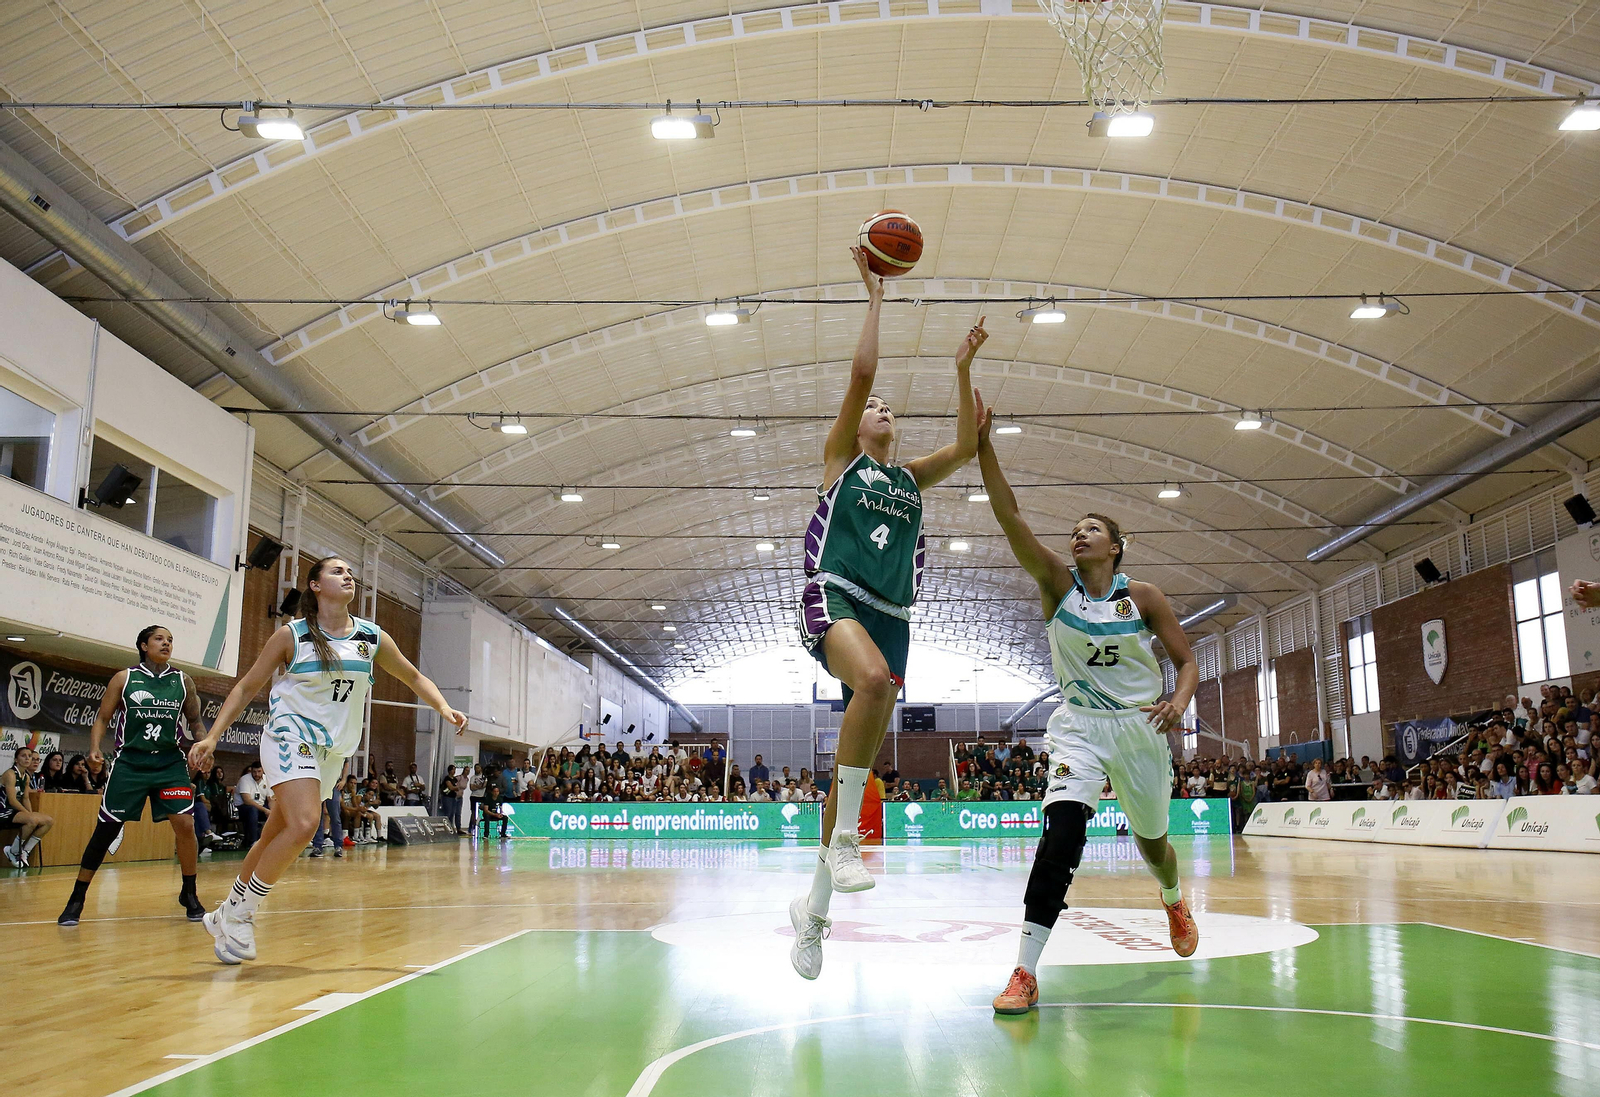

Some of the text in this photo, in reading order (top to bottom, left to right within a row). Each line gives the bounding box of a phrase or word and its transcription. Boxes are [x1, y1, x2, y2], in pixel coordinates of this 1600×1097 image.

[21, 504, 219, 587] JUGADORES DE CANTERA QUE HAN DEBUTADO CON EL PRIMER EQUIPO
[870, 523, 890, 550] 4
[1086, 642, 1120, 667] 25
[46, 670, 106, 700] Federació
[330, 678, 354, 702] 17
[64, 703, 79, 724] de
[152, 698, 180, 708] Unicaja
[143, 723, 162, 742] 34
[226, 726, 262, 746] Baloncest
[550, 809, 759, 836] Creo en el emprendimiento
[959, 809, 997, 829] Creo
[1000, 812, 1020, 828] en
[1023, 807, 1038, 828] el
[1359, 818, 1376, 828] Unicaja
[1400, 817, 1421, 828] Unicaja
[1462, 818, 1484, 829] Unicaja
[1521, 821, 1549, 835] Unicaja
